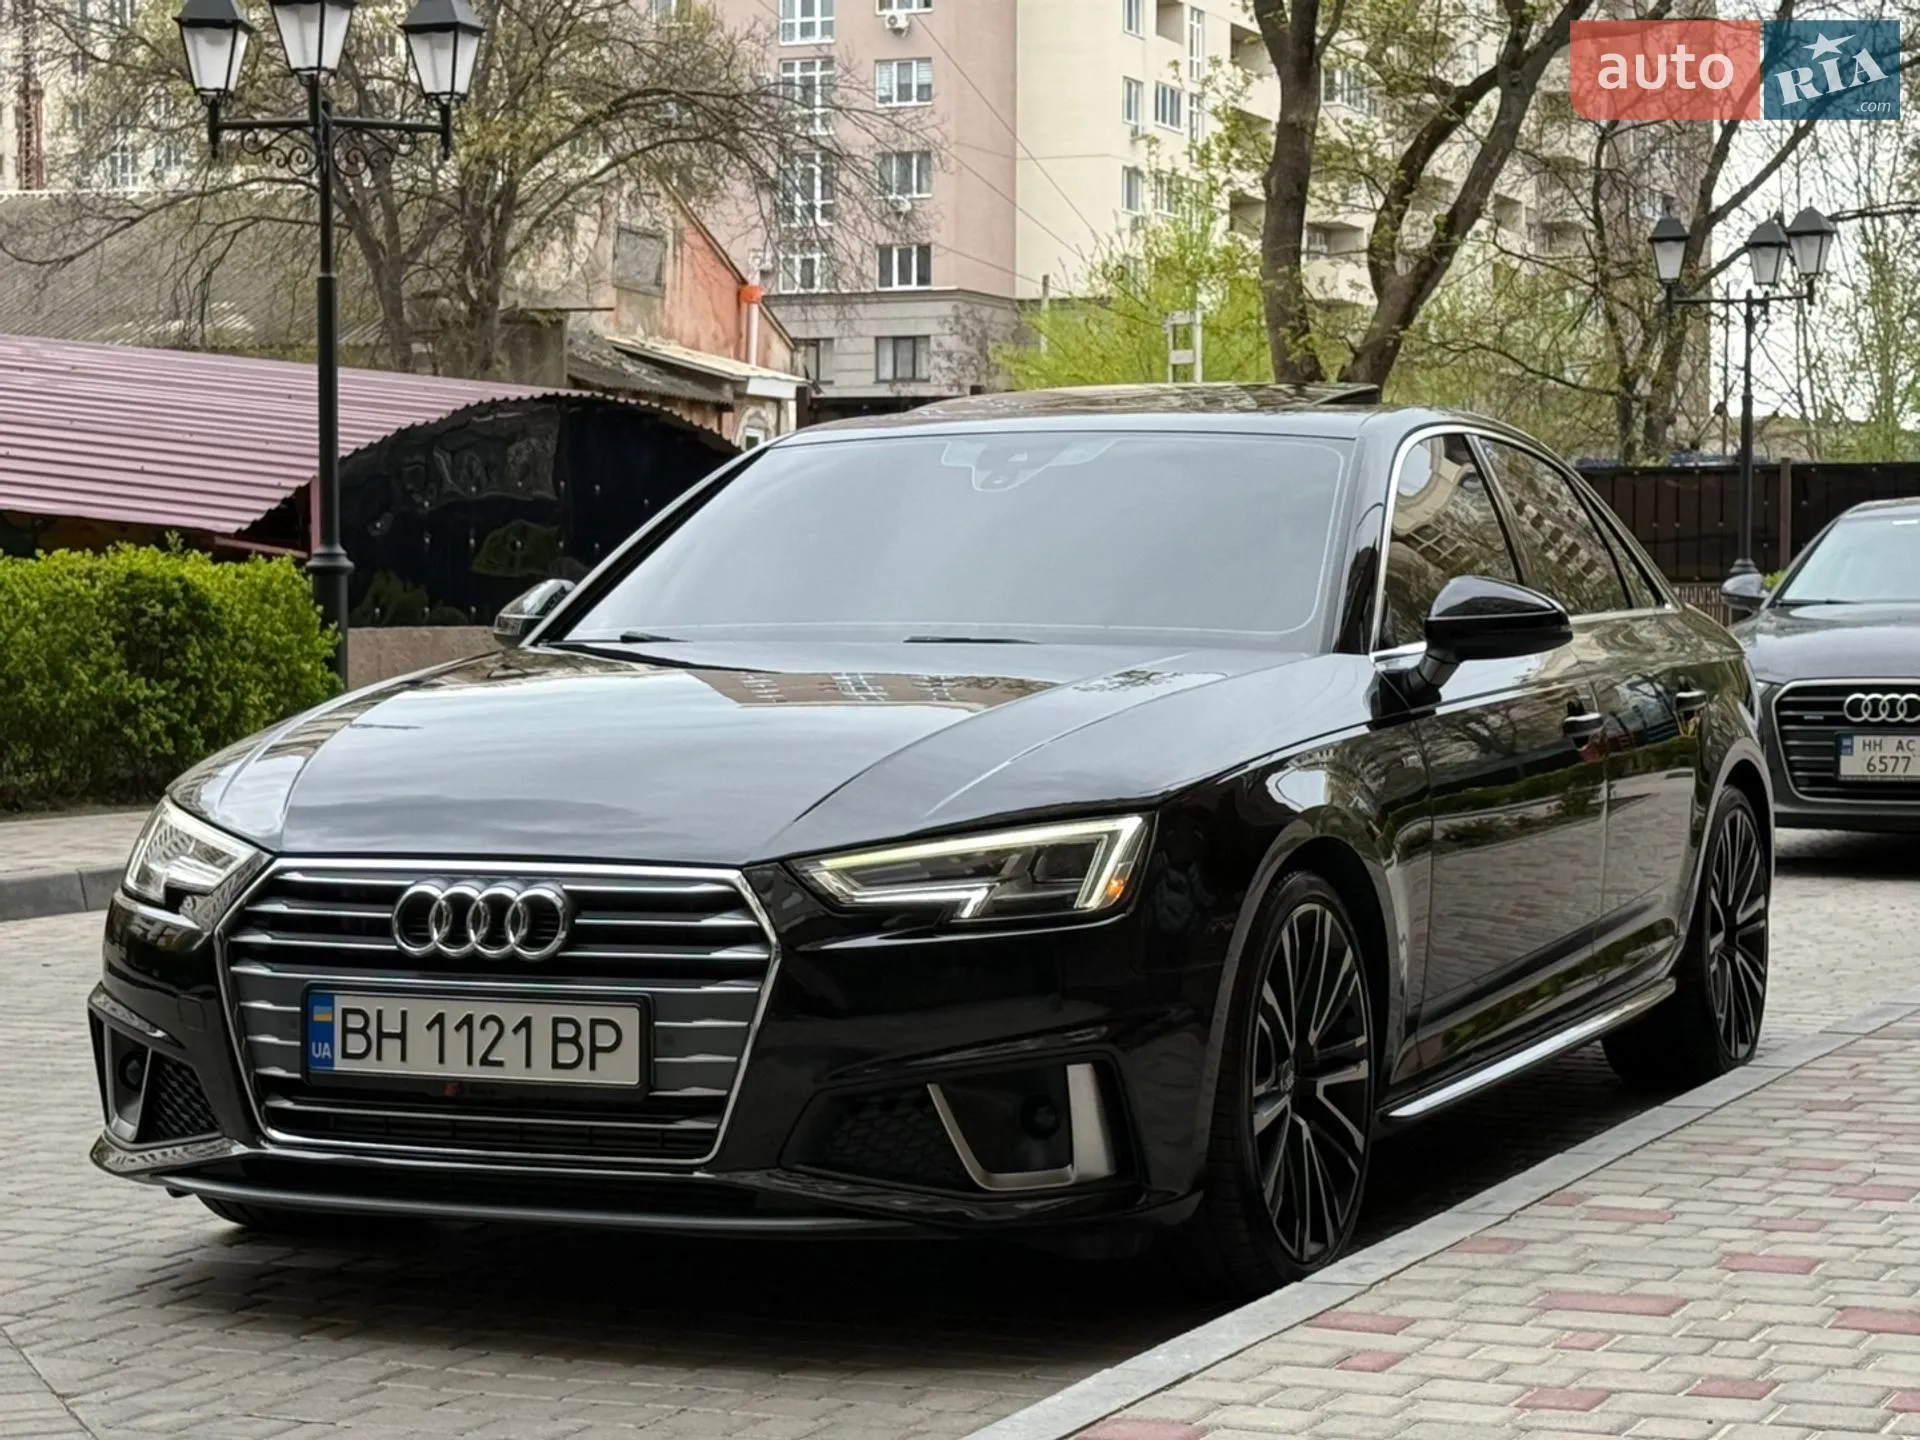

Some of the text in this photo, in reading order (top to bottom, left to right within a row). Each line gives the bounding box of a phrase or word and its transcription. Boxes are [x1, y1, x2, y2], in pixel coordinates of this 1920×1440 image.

[1862, 739, 1916, 752] HH AC
[1866, 755, 1912, 773] 6577
[340, 1007, 624, 1072] BH 1121 BP
[312, 1041, 332, 1060] UA
